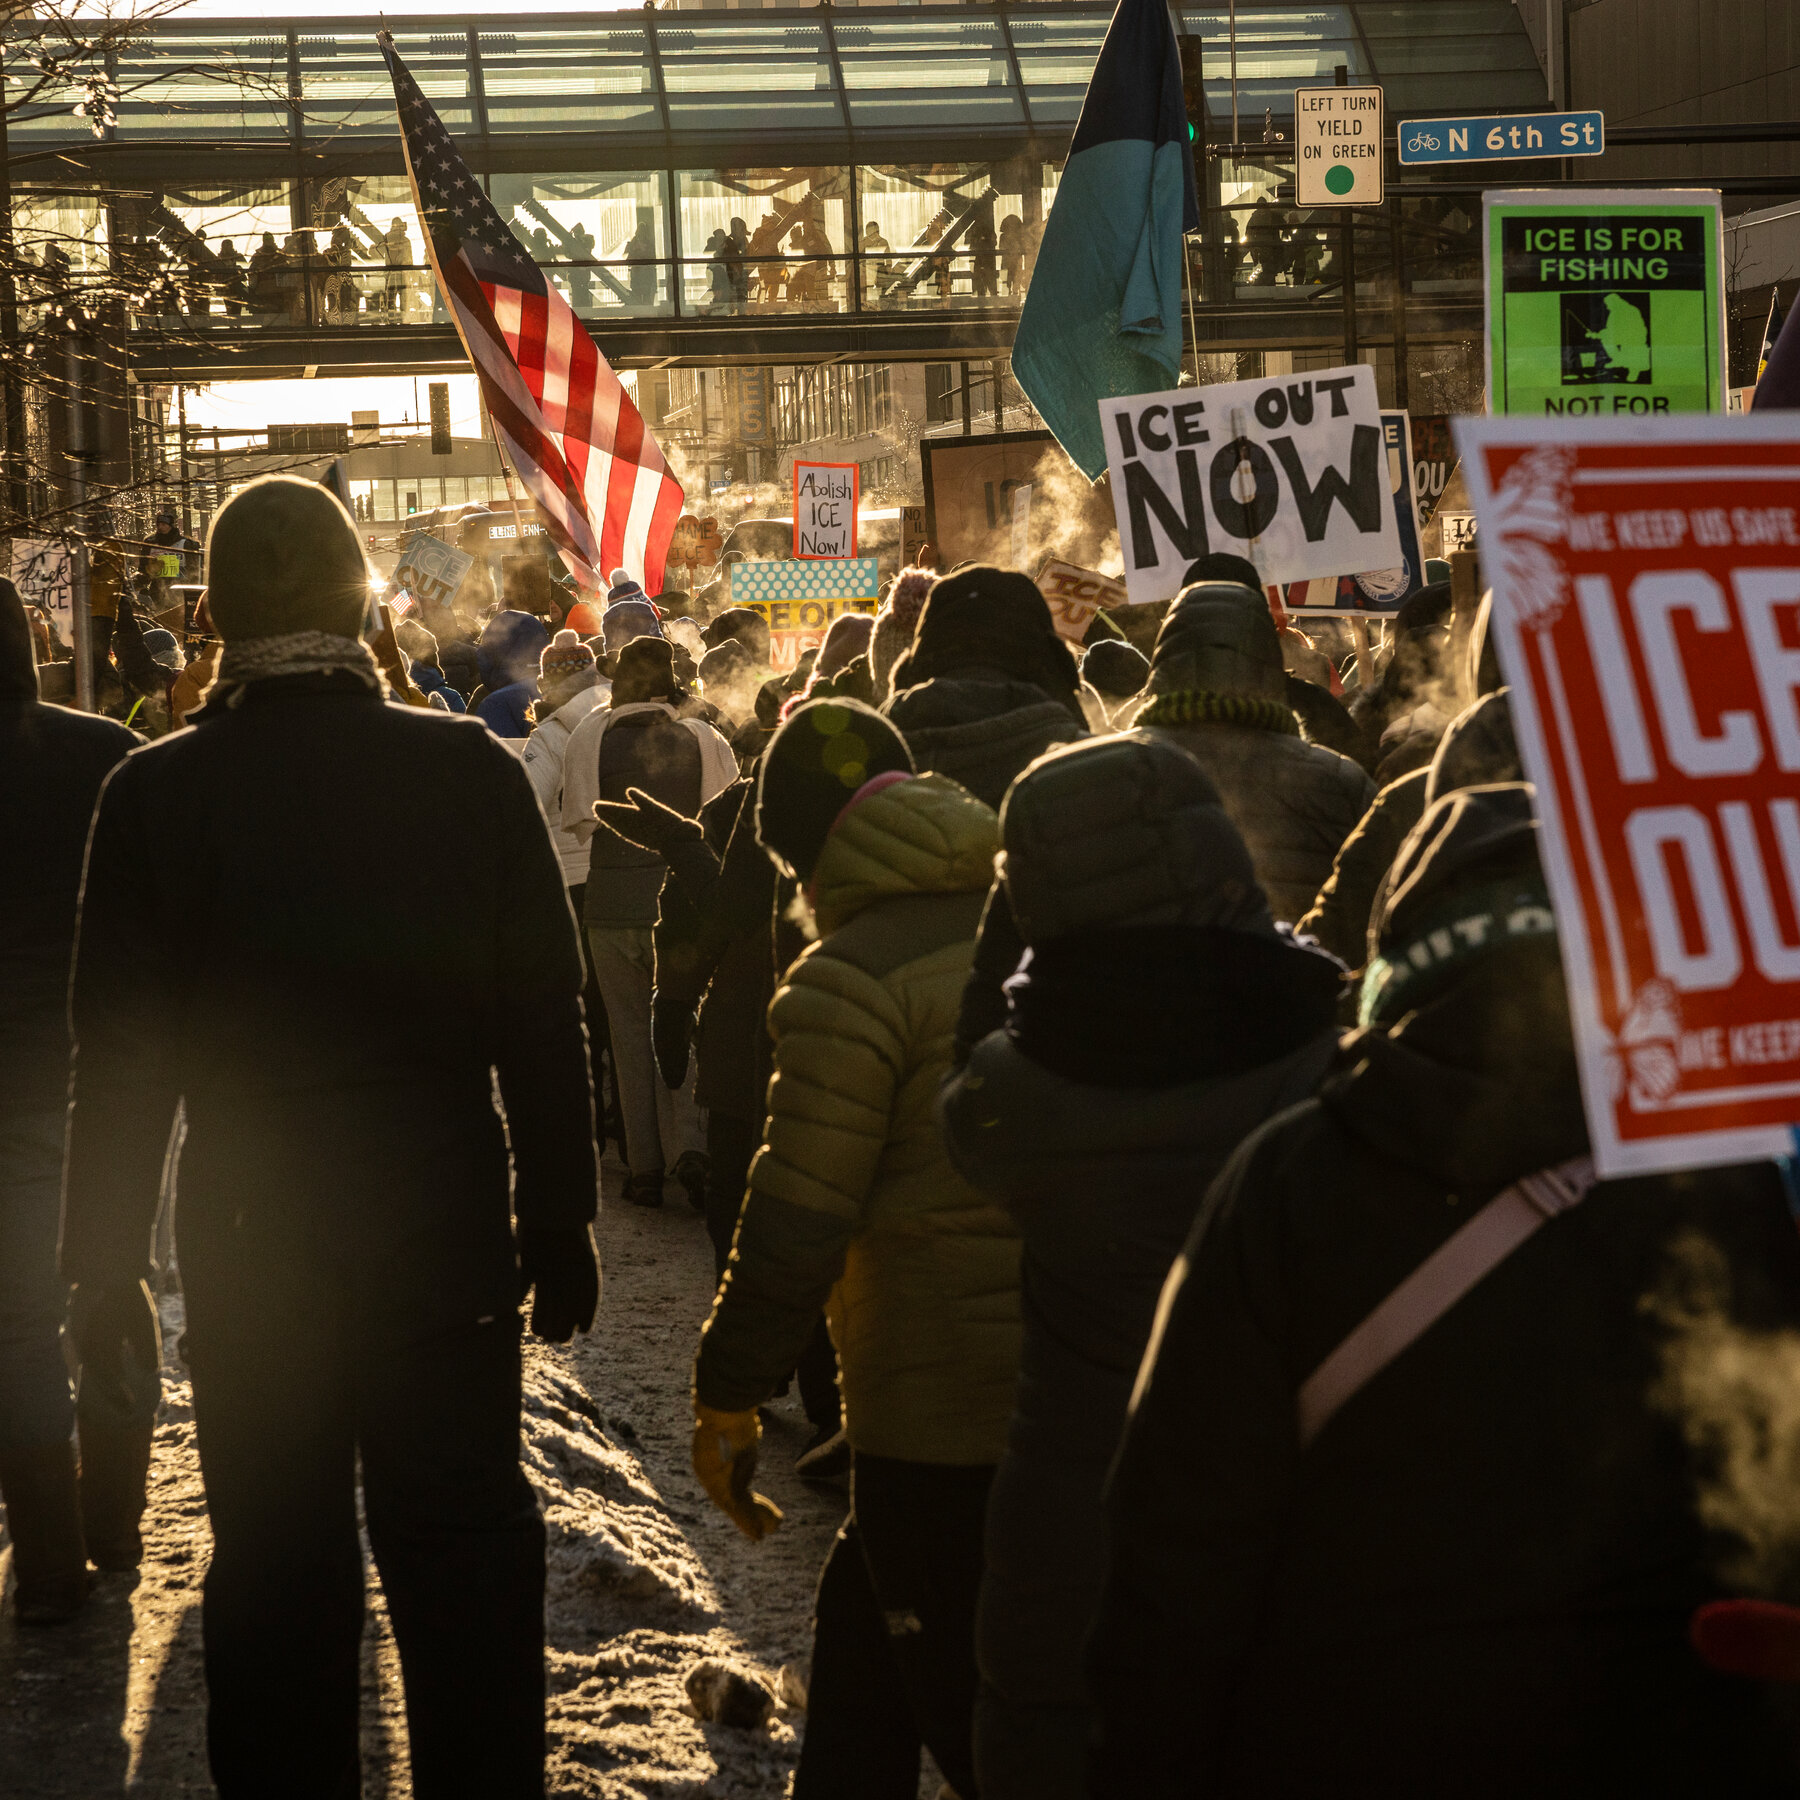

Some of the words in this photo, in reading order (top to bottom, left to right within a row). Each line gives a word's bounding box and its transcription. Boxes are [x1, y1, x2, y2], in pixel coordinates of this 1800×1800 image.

[1302, 98, 1333, 111] LEFT
[1342, 97, 1376, 110] TURN
[1318, 120, 1362, 136] YIELD
[1449, 128, 1468, 152] N
[1486, 125, 1543, 150] 6th
[1560, 122, 1595, 146] St
[1304, 145, 1321, 158] ON
[1333, 144, 1375, 158] GREEN
[1525, 229, 1575, 251] ICE
[1585, 229, 1612, 251] IS
[1622, 228, 1683, 250] FOR
[1541, 258, 1668, 281] FISHING
[1115, 400, 1210, 459] ICE
[1254, 375, 1356, 429] OUT
[1545, 396, 1604, 417] NOT
[1613, 395, 1669, 417] FOR
[798, 473, 852, 500] Abolish
[1412, 460, 1446, 497] OU
[1122, 424, 1382, 569] NOW
[811, 502, 842, 528] ICE
[1569, 513, 1615, 551] WE
[1614, 509, 1688, 549] KEEP
[1689, 507, 1733, 546] US
[1731, 506, 1799, 546] SAFE
[672, 521, 713, 539] HAME
[801, 530, 846, 558] Now!
[406, 539, 466, 585] ICE
[672, 545, 705, 560] ICE
[396, 565, 453, 608] OUT
[1044, 572, 1127, 611] ICE
[1045, 596, 1096, 625] OU
[1680, 1027, 1728, 1070] WE
